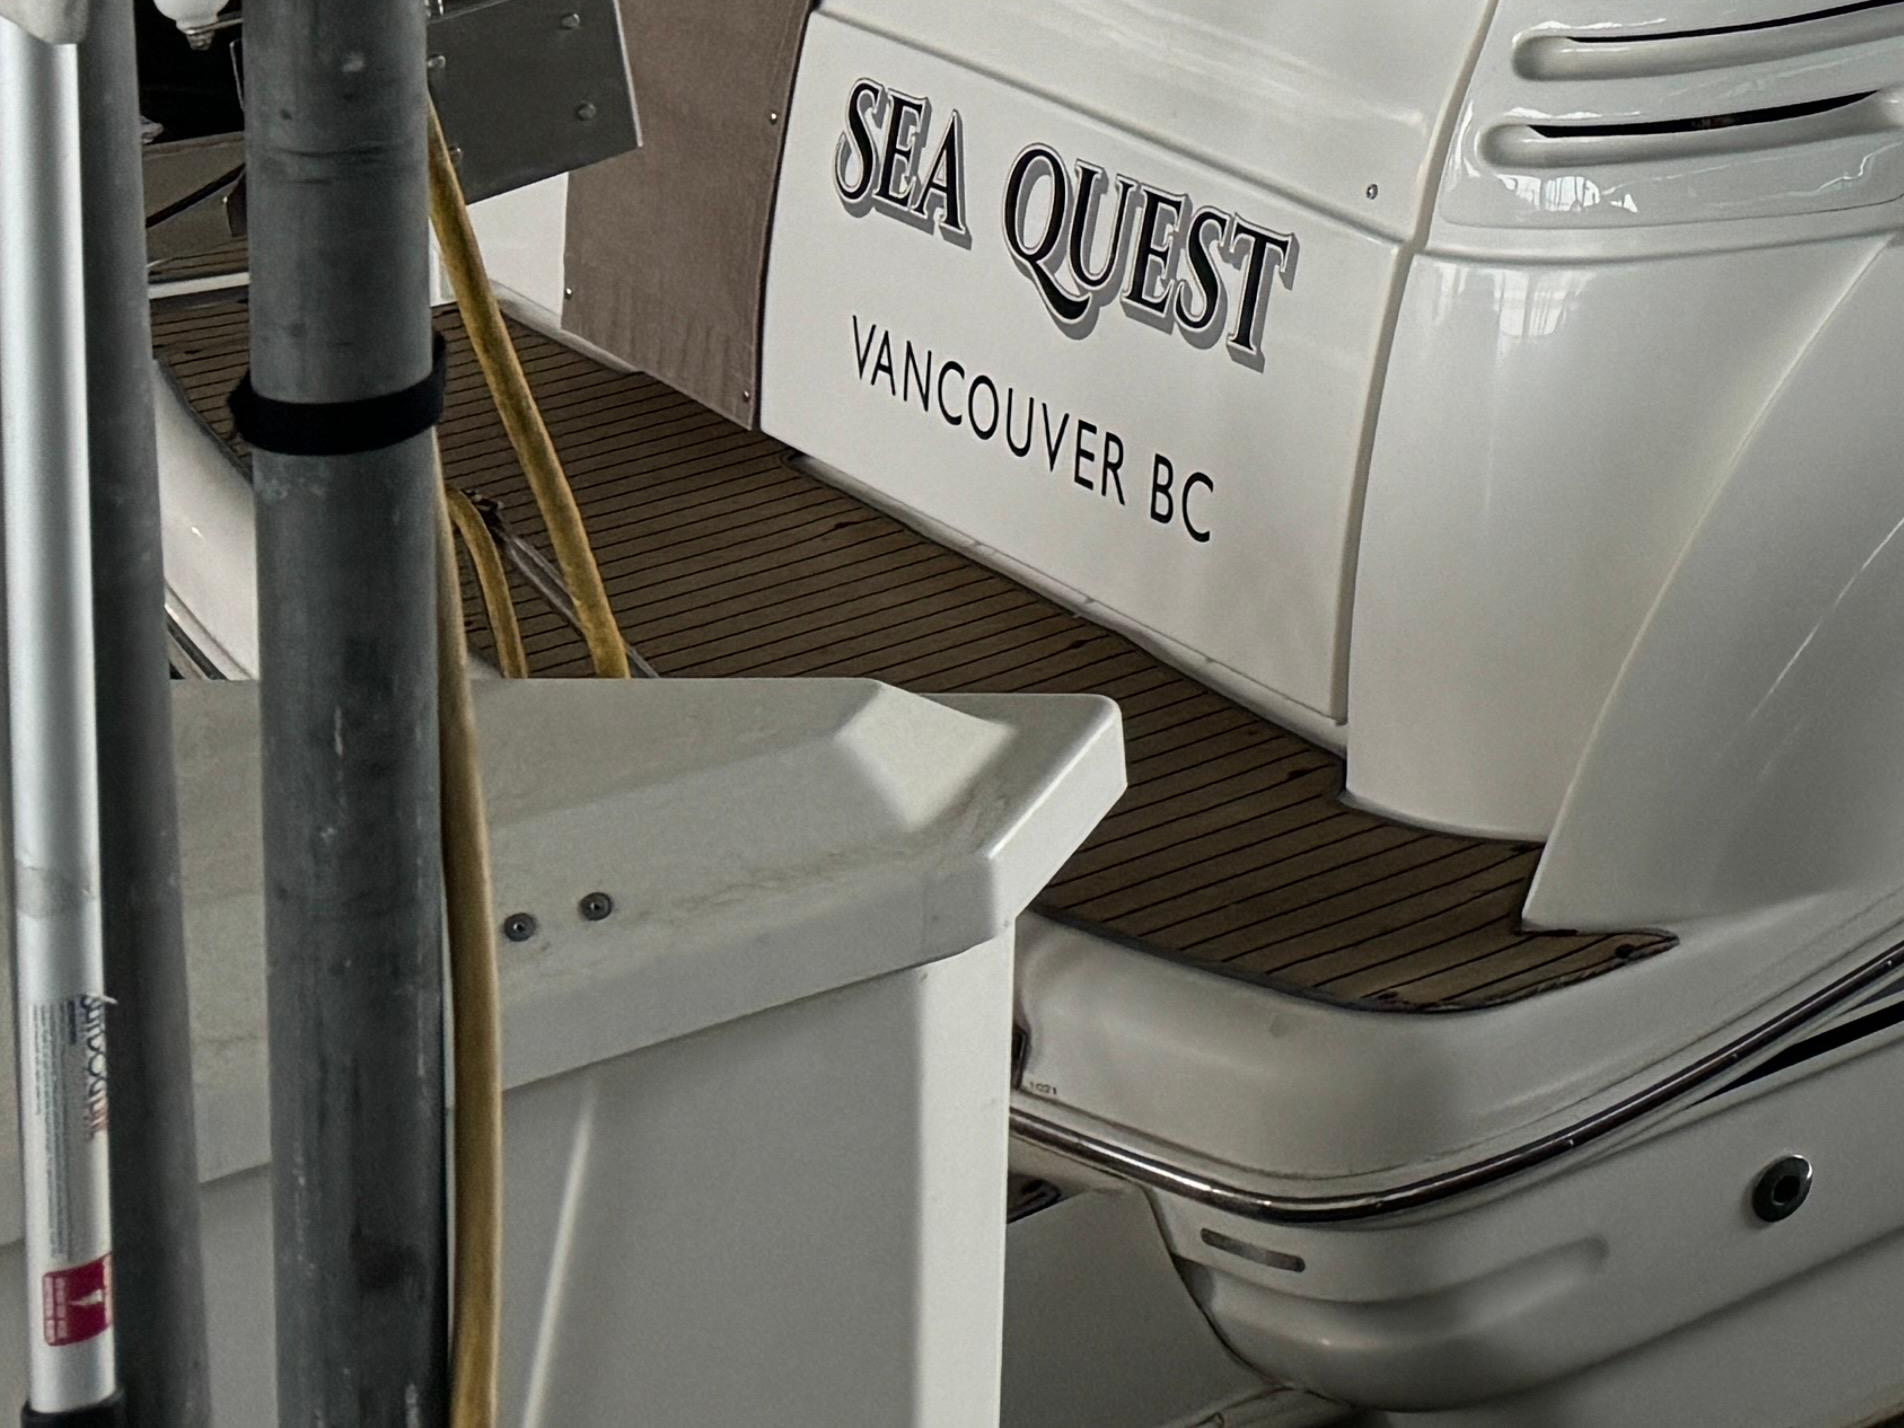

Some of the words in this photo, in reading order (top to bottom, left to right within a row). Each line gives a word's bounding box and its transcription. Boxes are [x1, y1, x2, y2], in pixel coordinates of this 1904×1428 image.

[833, 77, 972, 251] SEA
[1002, 142, 1300, 373] QUEST
[851, 314, 1126, 507] VANCOUVER
[1149, 453, 1214, 544] BC
